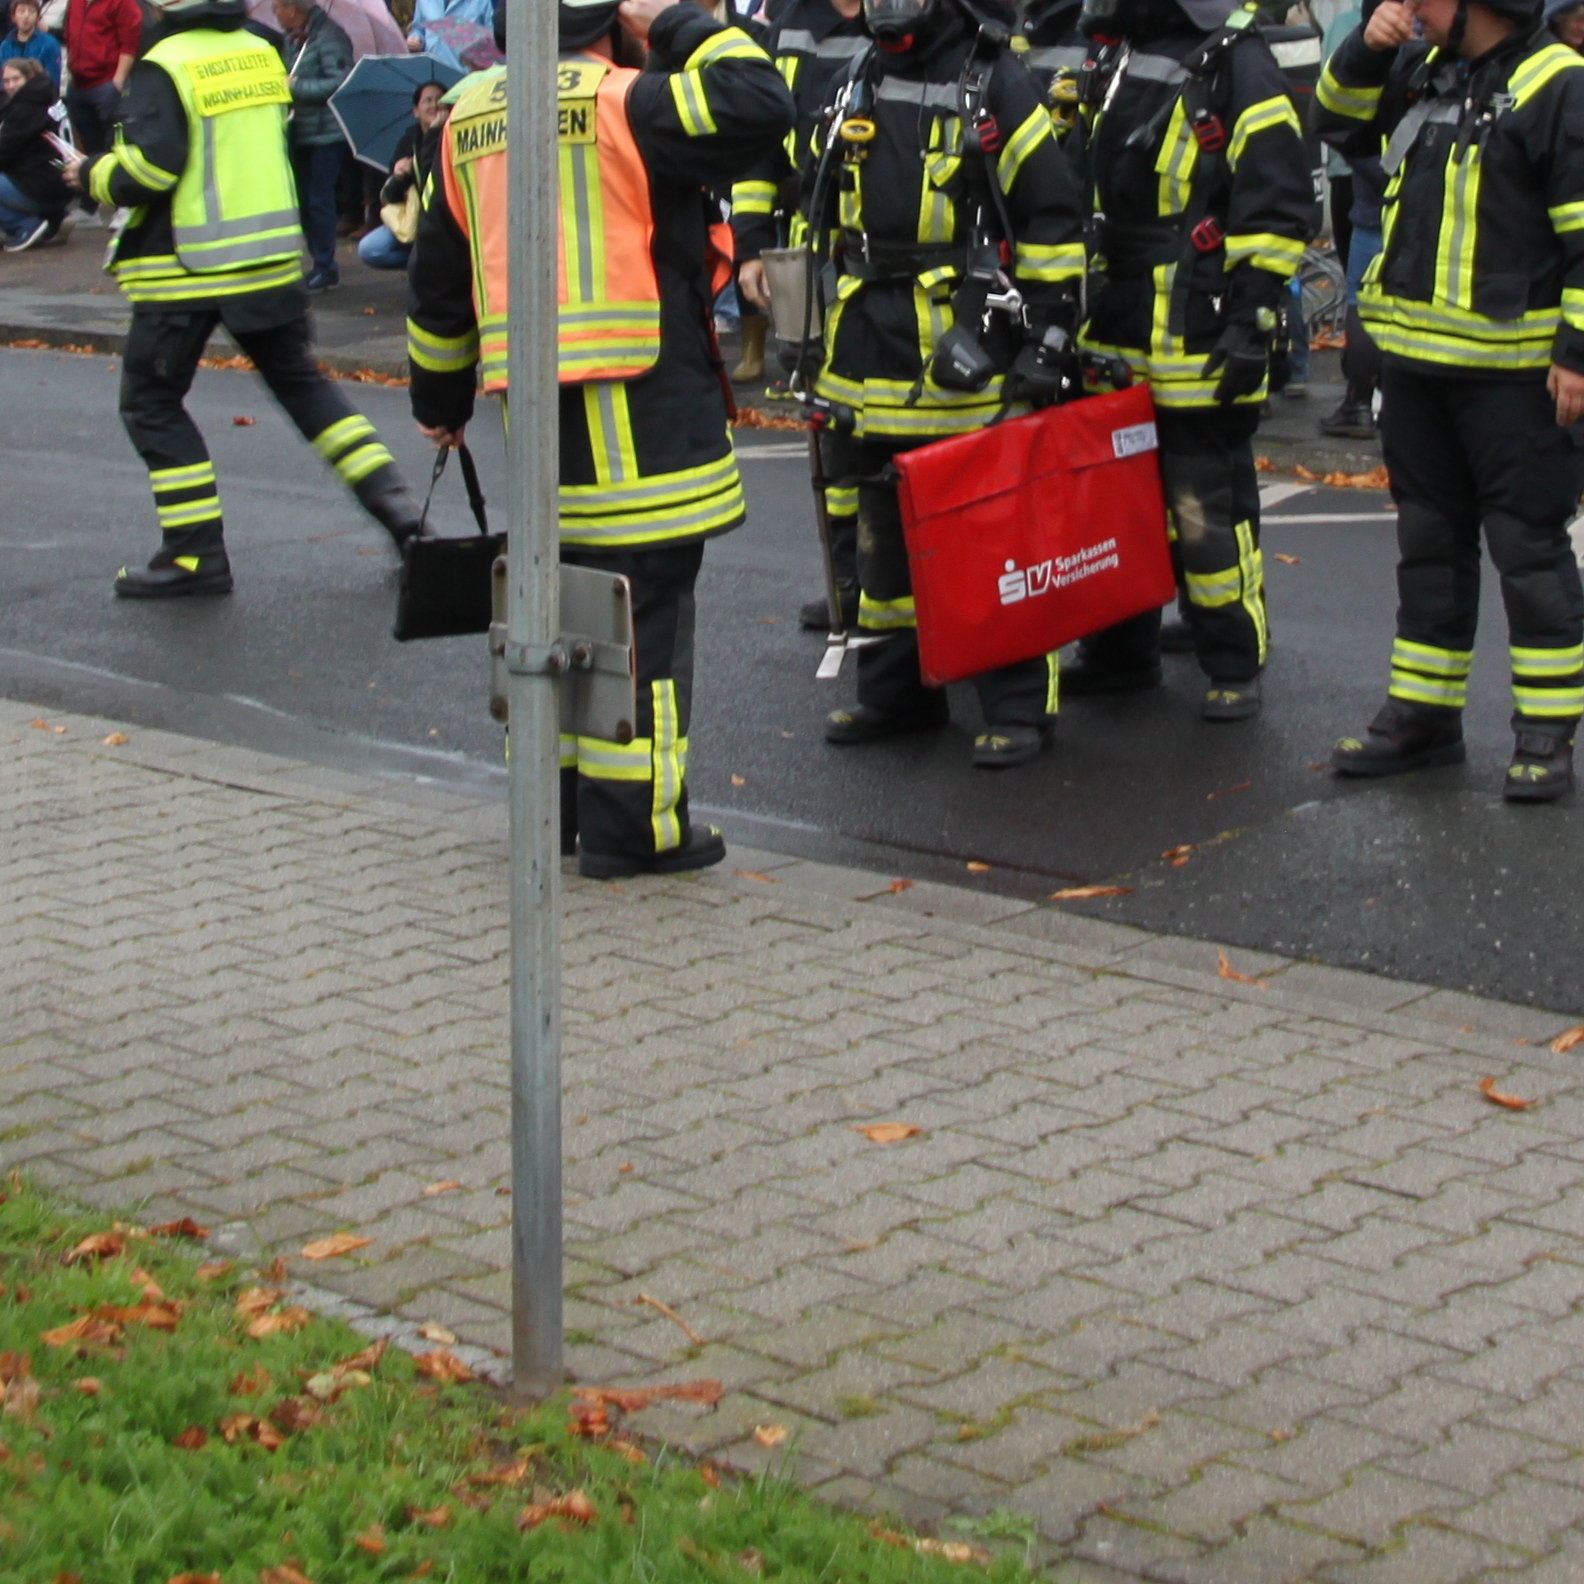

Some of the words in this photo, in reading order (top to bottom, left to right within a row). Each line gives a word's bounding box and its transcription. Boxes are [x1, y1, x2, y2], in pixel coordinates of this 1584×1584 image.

[456, 108, 587, 156] MAINHEN
[1051, 553, 1119, 589] Versicherung
[1055, 537, 1116, 572] Sparkassen
